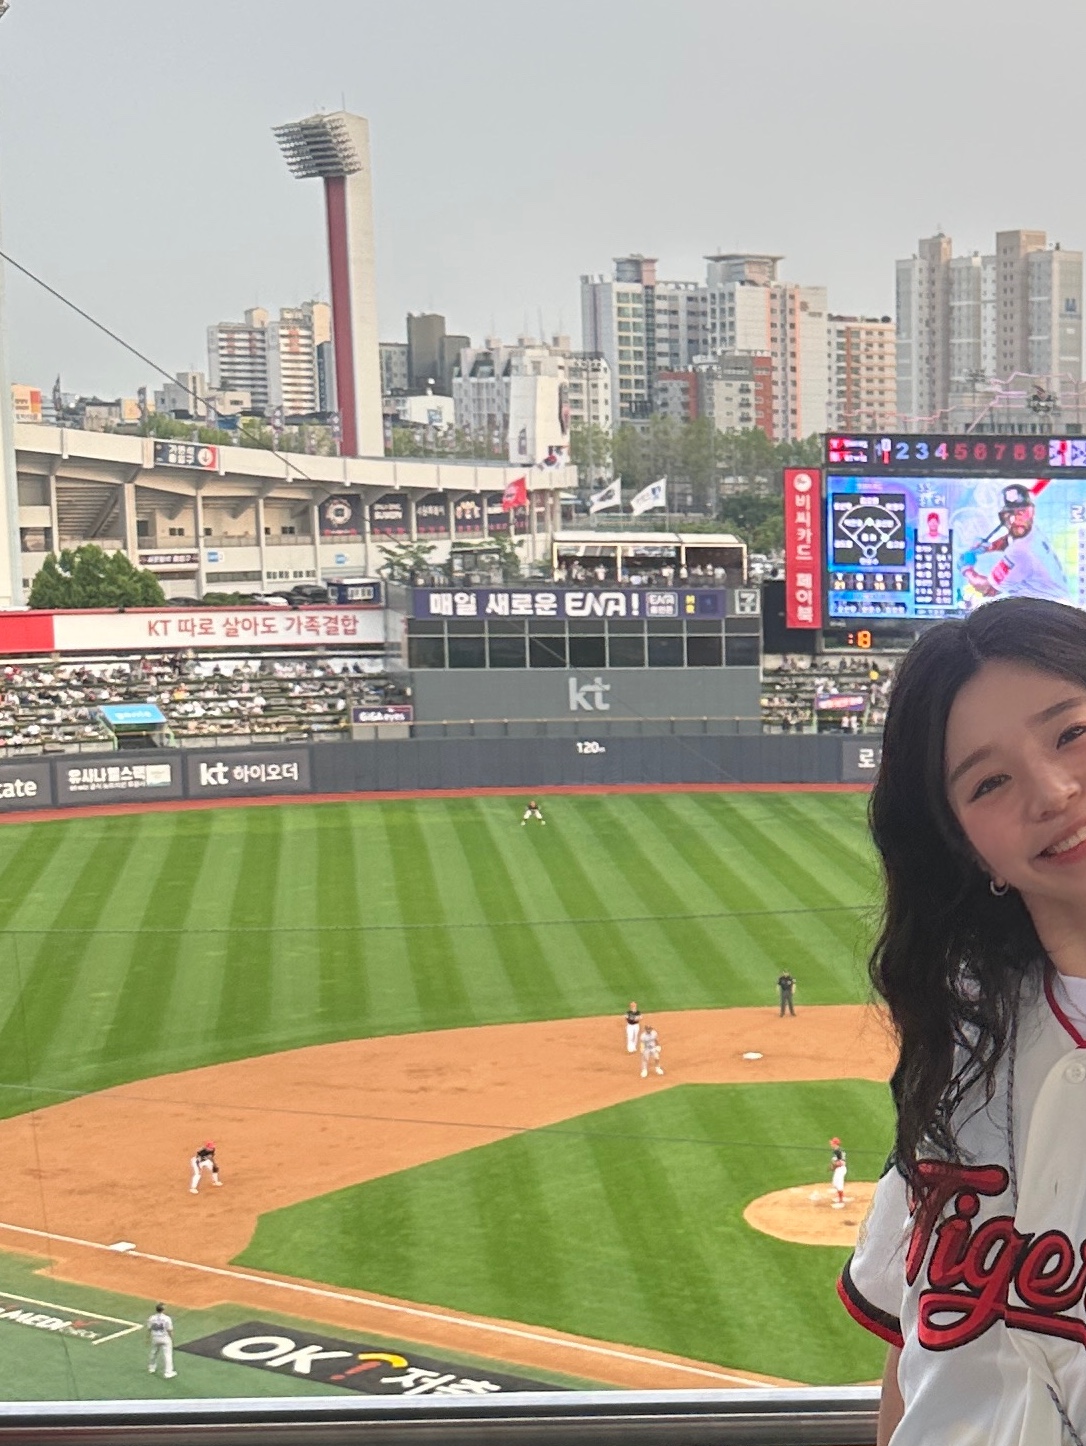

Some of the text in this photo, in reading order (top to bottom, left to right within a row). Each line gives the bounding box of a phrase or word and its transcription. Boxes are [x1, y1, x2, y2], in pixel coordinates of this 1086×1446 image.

[895, 442, 910, 460] 2
[915, 442, 930, 460] 3
[934, 442, 949, 460] 4
[954, 442, 968, 460] 5
[994, 443, 1007, 461] 7
[429, 592, 477, 616] 매일
[485, 592, 558, 616] 새로운
[147, 614, 359, 638] KT 따로 살아도 가족결합
[568, 677, 612, 711] kt
[200, 762, 299, 786] kt 하이오더
